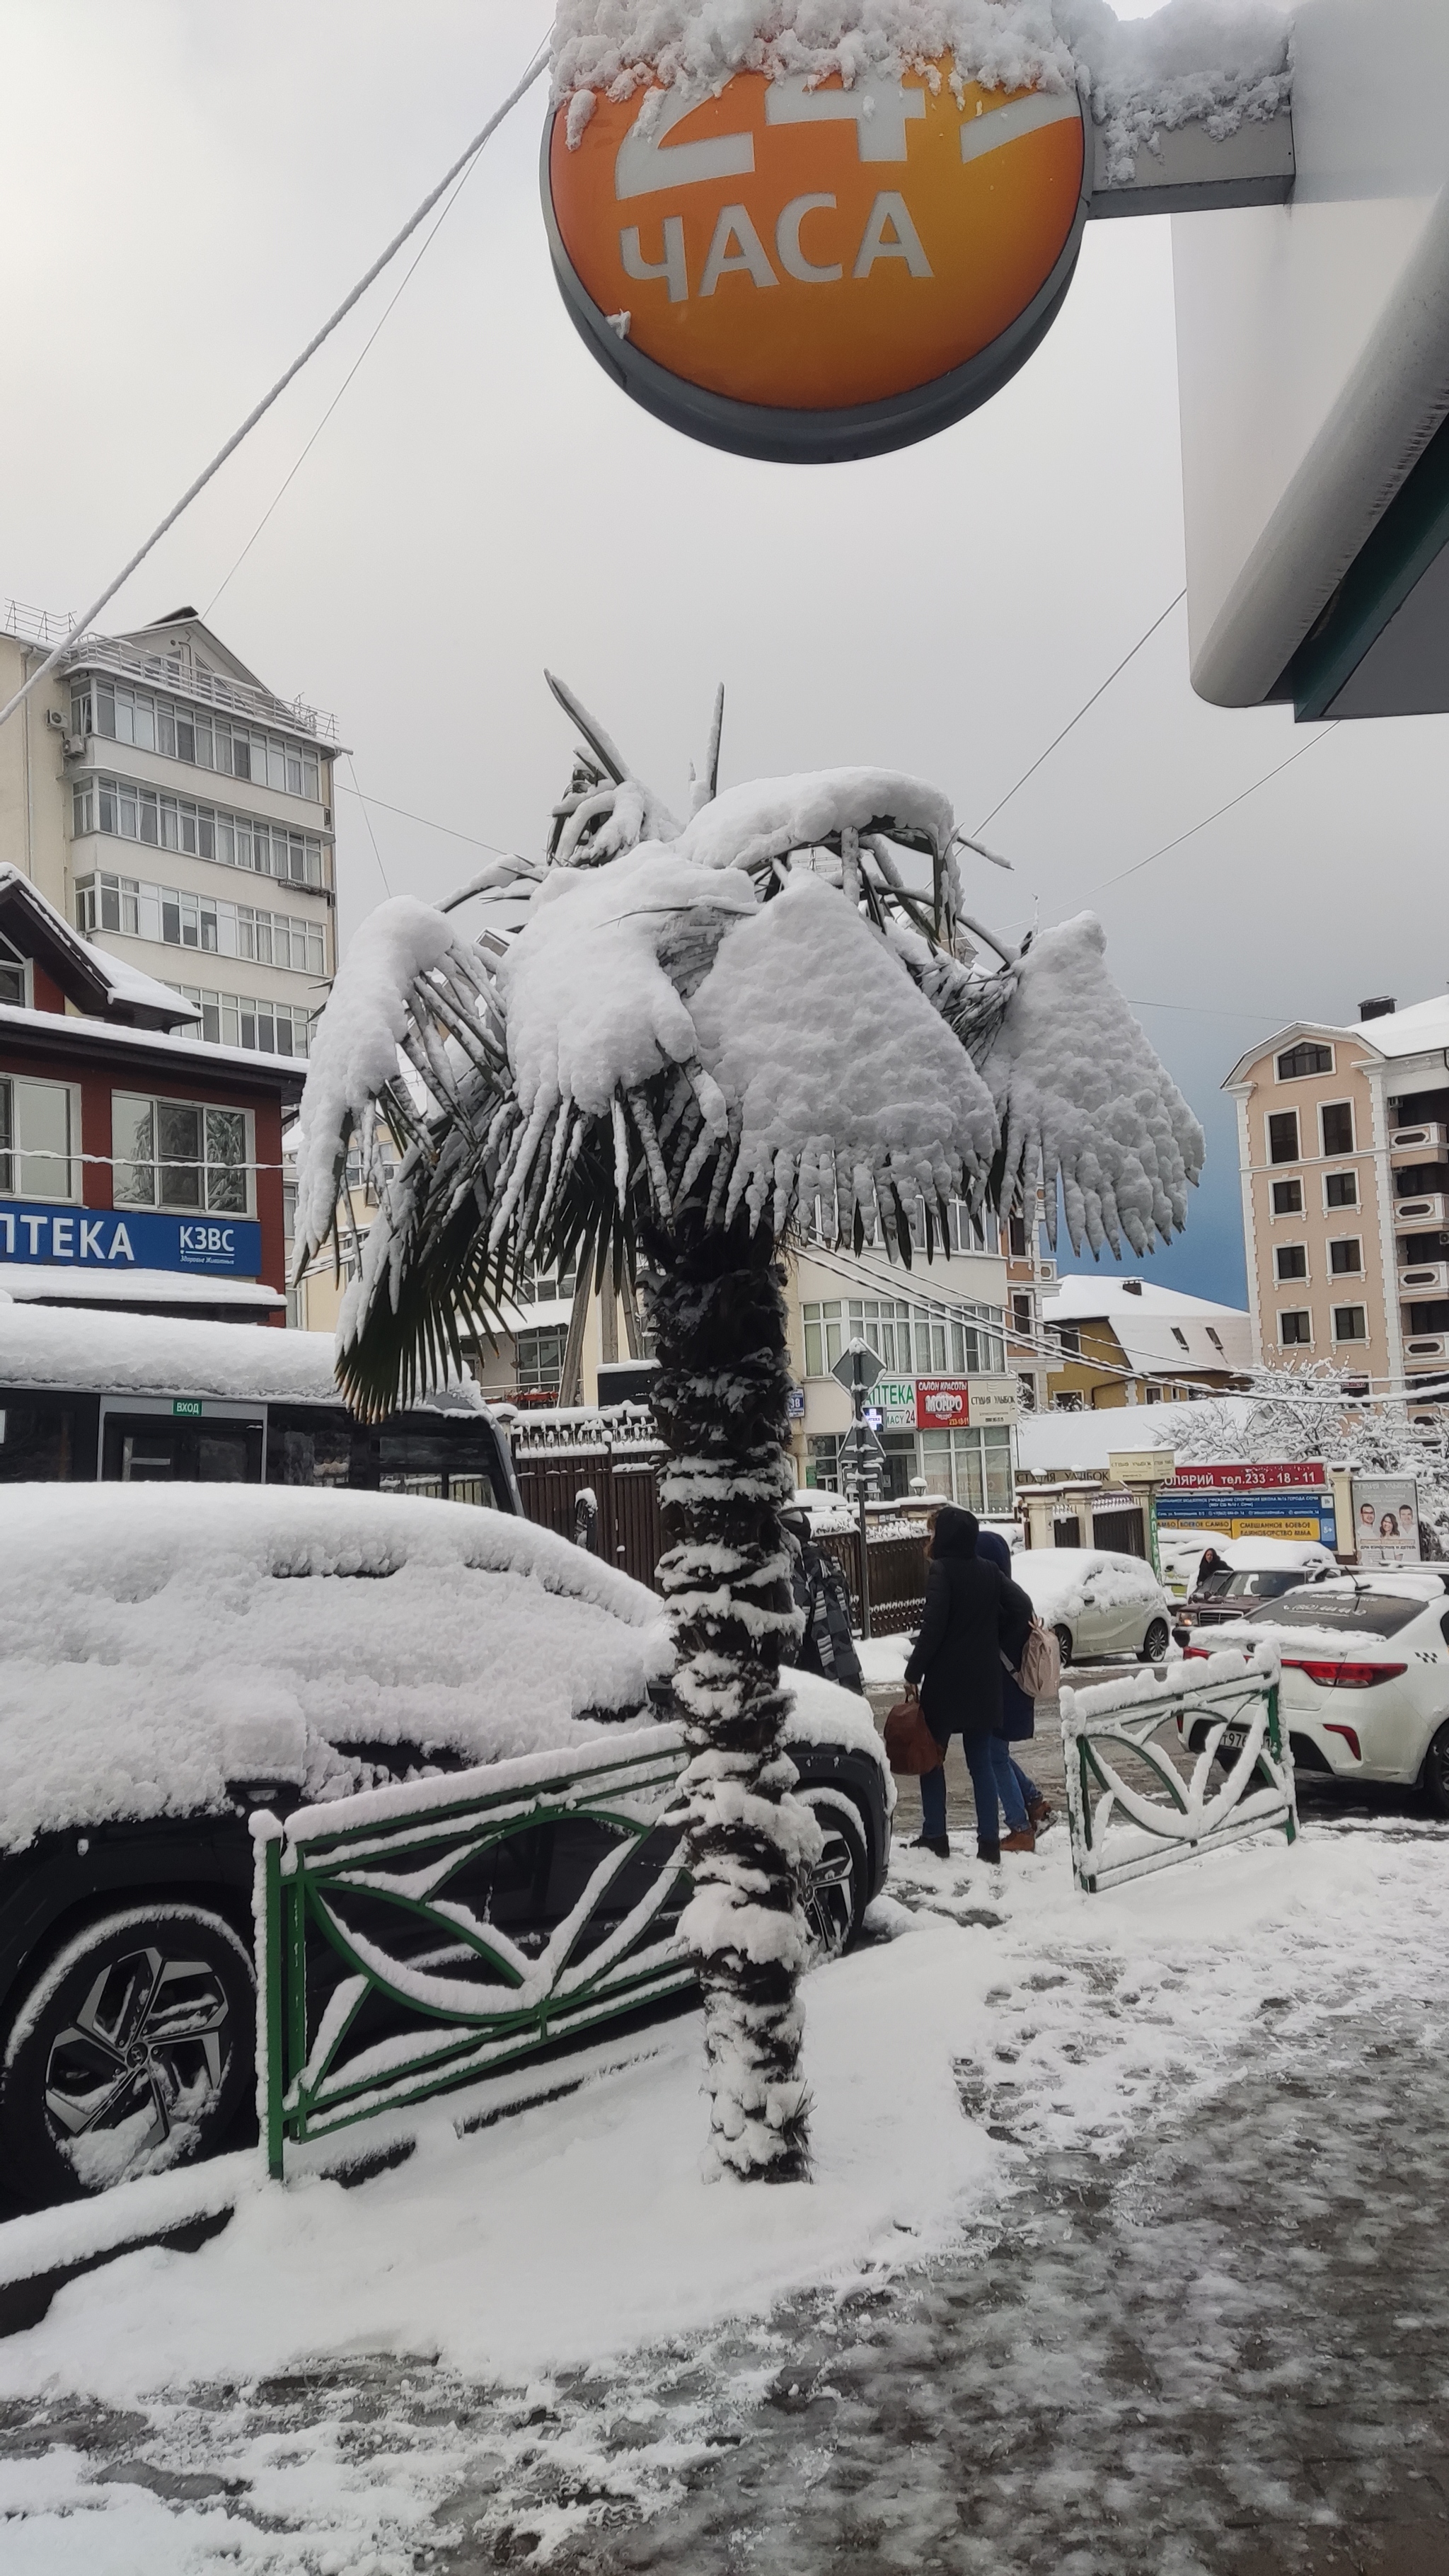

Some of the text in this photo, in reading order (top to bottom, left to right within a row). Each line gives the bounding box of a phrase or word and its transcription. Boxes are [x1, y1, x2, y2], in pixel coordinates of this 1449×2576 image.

[619, 190, 934, 304] ЧАСА
[180, 1225, 235, 1252] КЗВС
[918, 1381, 967, 1391] САЛОН КРАСОТЫ
[176, 1402, 200, 1415] ВХОД
[906, 1409, 916, 1424] 24
